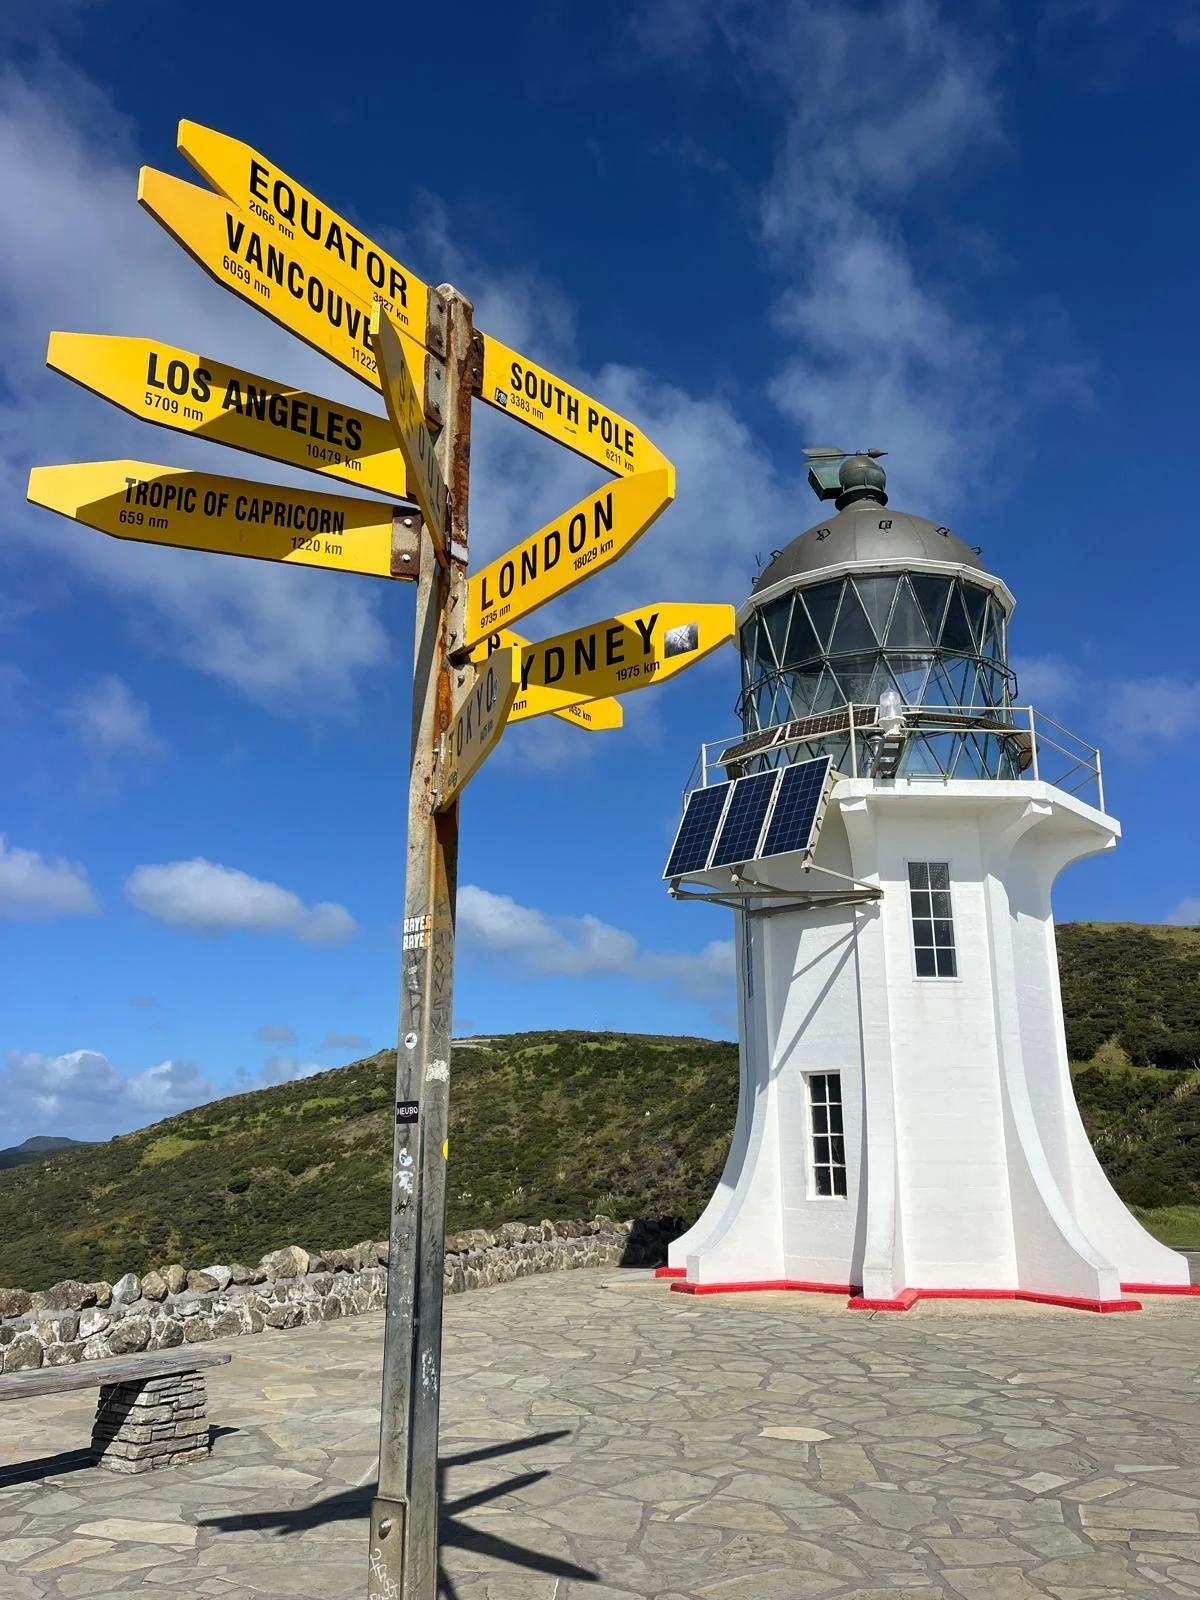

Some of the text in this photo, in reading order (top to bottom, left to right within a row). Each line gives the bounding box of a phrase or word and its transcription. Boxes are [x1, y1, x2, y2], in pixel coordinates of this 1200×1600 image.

[249, 200, 294, 240] 2066 nm
[249, 158, 408, 308] EQUATOR
[223, 255, 271, 300] 6059 nm
[225, 211, 375, 354] VANCOUVE
[396, 308, 409, 326] km
[351, 347, 377, 374] 11222
[144, 392, 204, 423] 5709 nm
[147, 352, 211, 403] LOS
[222, 379, 362, 451] ANGELES
[510, 393, 530, 413] 3383
[532, 407, 544, 420] nm
[510, 361, 634, 458] SOUTH POLE
[306, 443, 362, 472] 10479 km
[605, 448, 634, 473] 6211 km
[119, 510, 168, 530] 659 nm
[125, 477, 345, 537] TROPIC OF CAPRICORN
[291, 536, 343, 556] 1220 km
[481, 492, 613, 611] LONDON
[573, 537, 614, 571] 18029 km
[481, 602, 511, 629] 9735 nm
[520, 613, 659, 691] YDNEY
[616, 660, 660, 682] 1975 km
[449, 666, 494, 767] TOKYO
